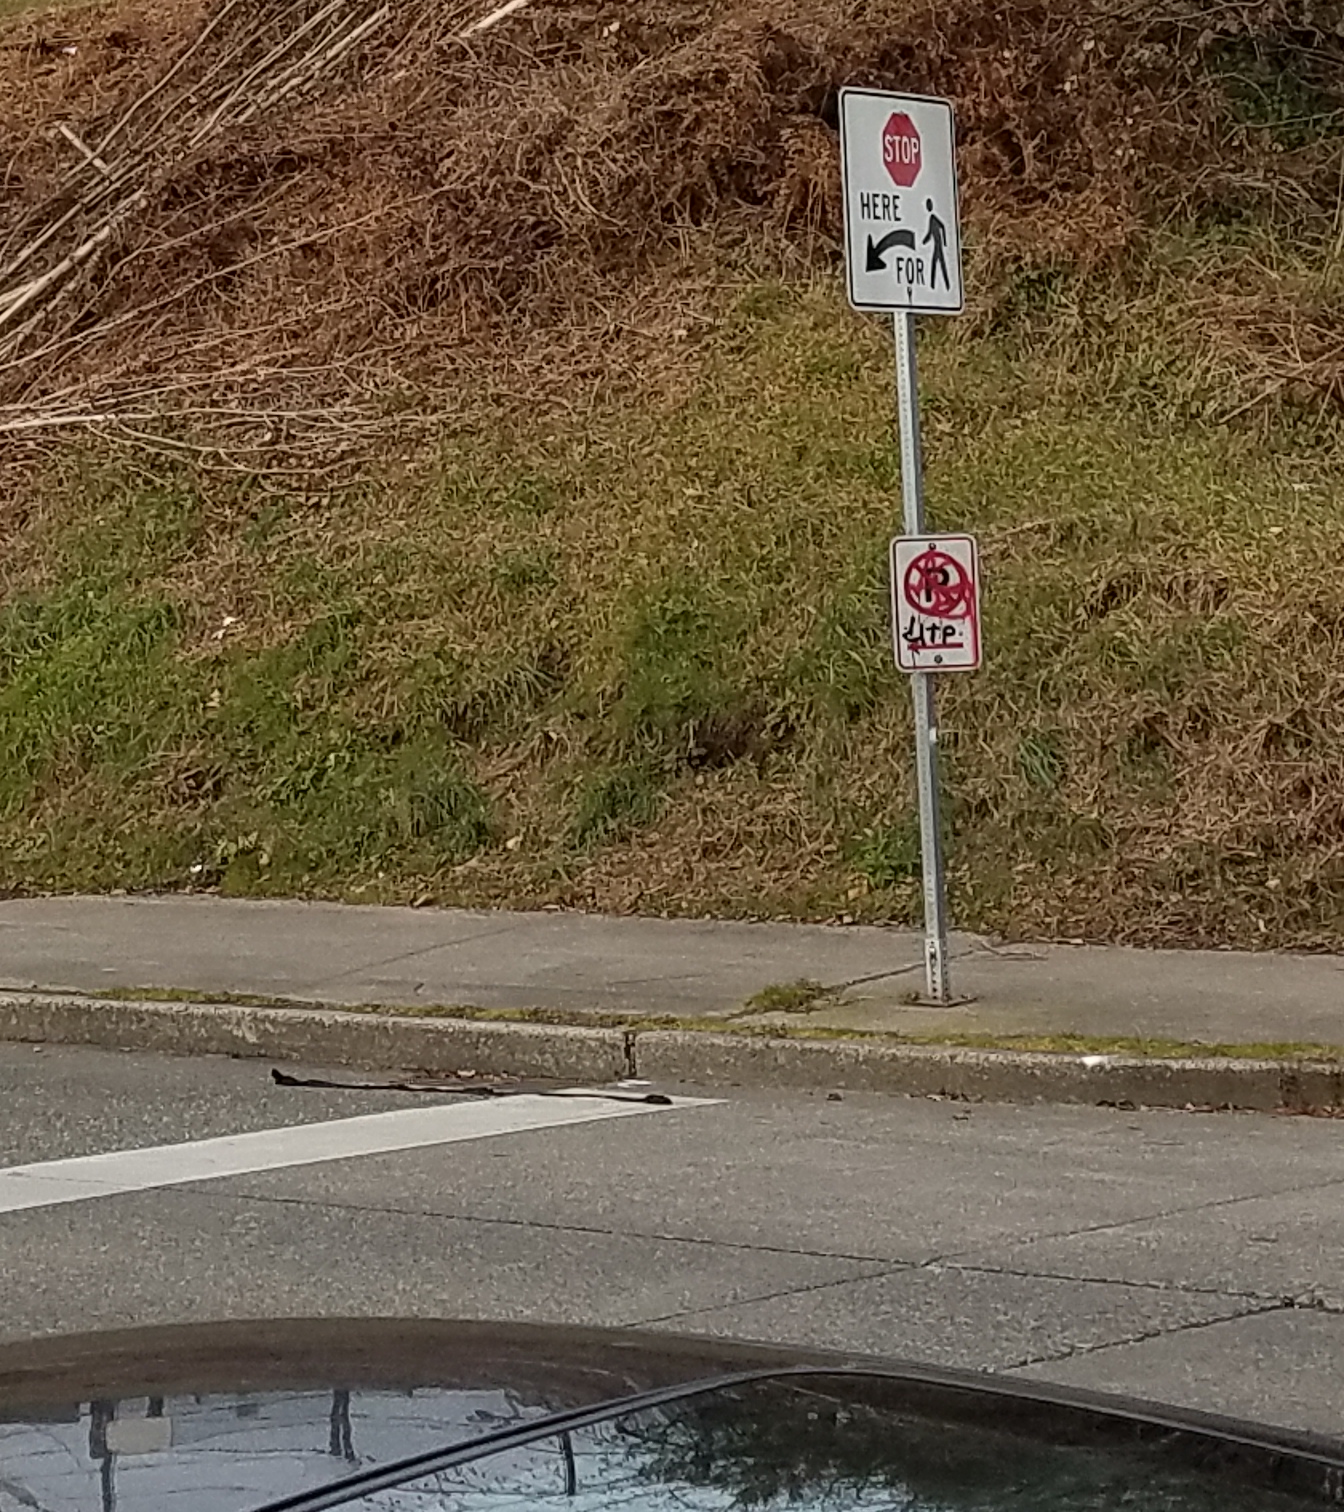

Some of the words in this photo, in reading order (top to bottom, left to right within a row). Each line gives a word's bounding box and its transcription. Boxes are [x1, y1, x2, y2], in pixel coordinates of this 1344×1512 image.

[884, 136, 919, 164] STOP
[860, 192, 902, 222] HERE
[896, 257, 925, 285] FOR
